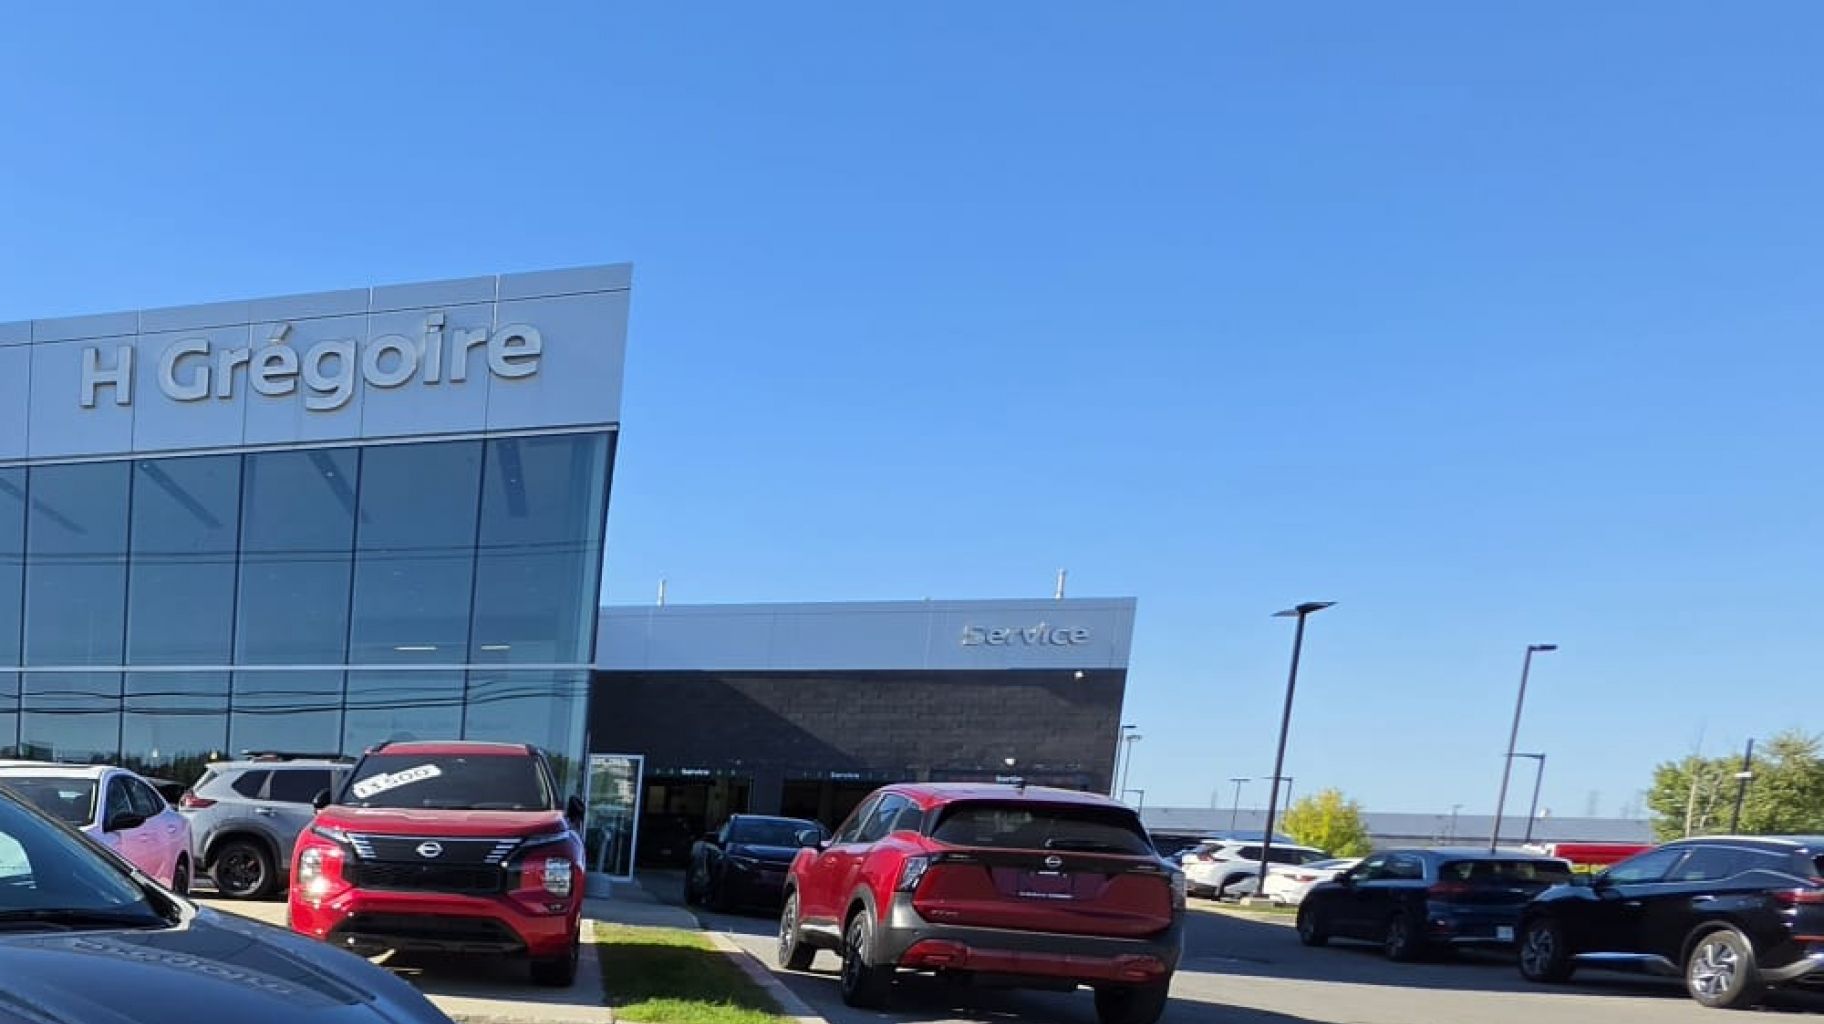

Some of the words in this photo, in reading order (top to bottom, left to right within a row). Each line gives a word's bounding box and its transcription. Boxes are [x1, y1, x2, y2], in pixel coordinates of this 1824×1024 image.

[79, 345, 133, 407] H
[158, 312, 543, 410] Grégoire
[961, 621, 1091, 647] Service
